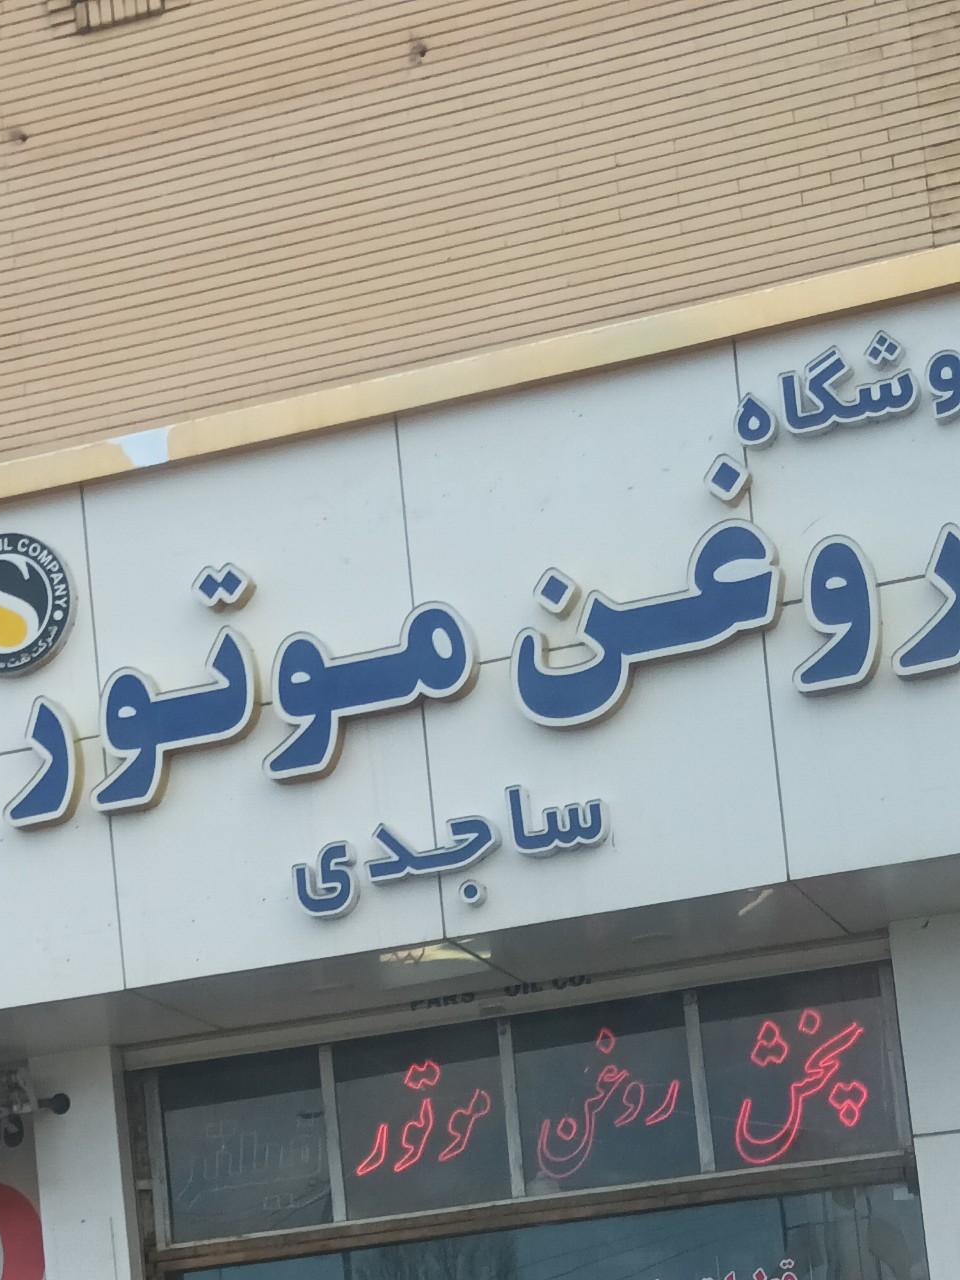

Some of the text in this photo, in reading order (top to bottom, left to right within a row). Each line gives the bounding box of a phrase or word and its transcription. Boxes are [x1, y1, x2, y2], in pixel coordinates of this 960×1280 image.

[17, 538, 68, 608] COMPANY
[2, 454, 960, 830] روغن موتور
[292, 783, 609, 920] ساجدی
[356, 1060, 491, 1176] موتور
[539, 1027, 680, 1179] روغن
